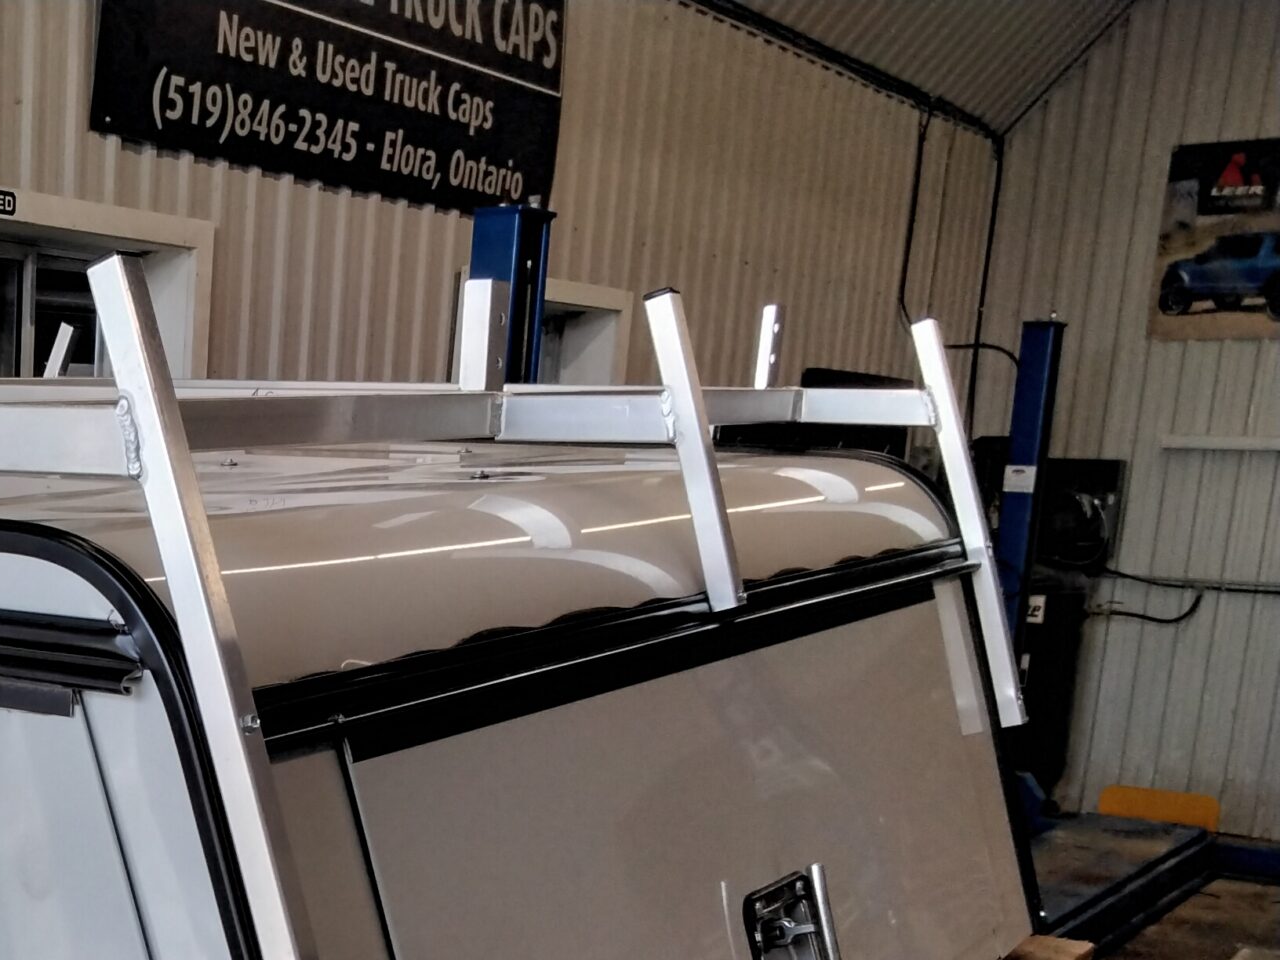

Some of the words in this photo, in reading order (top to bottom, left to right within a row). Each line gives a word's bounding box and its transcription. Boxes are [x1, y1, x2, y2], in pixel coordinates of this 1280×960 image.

[217, 10, 282, 70] New
[288, 37, 308, 79] &
[316, 40, 376, 97] Used
[384, 61, 442, 115] Truck
[448, 82, 494, 136] Caps
[493, 0, 559, 70] CAPS
[152, 66, 359, 162] (519)846-2345
[380, 129, 441, 190] Elora,
[448, 148, 524, 201] Ontario
